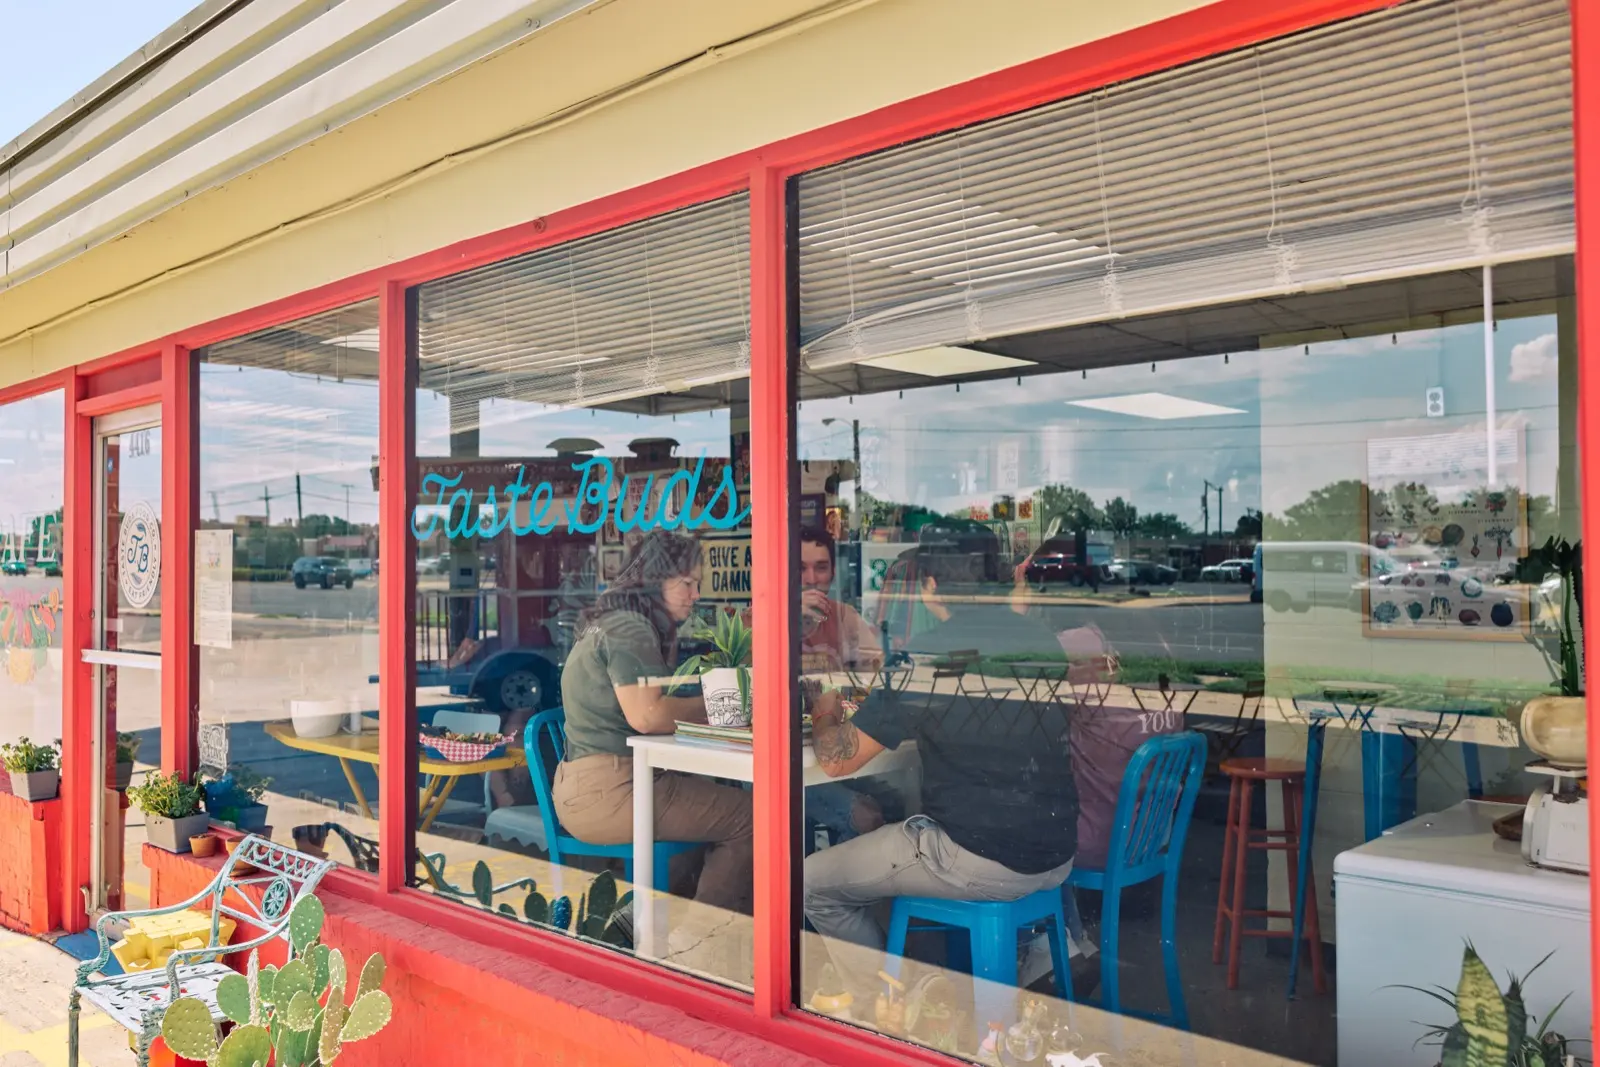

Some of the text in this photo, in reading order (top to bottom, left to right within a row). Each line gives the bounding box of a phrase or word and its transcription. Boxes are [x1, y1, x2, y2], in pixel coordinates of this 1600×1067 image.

[130, 430, 151, 458] 4416
[411, 448, 752, 541] Taste Buds
[709, 545, 739, 568] GIVE
[712, 570, 751, 592] DAMN
